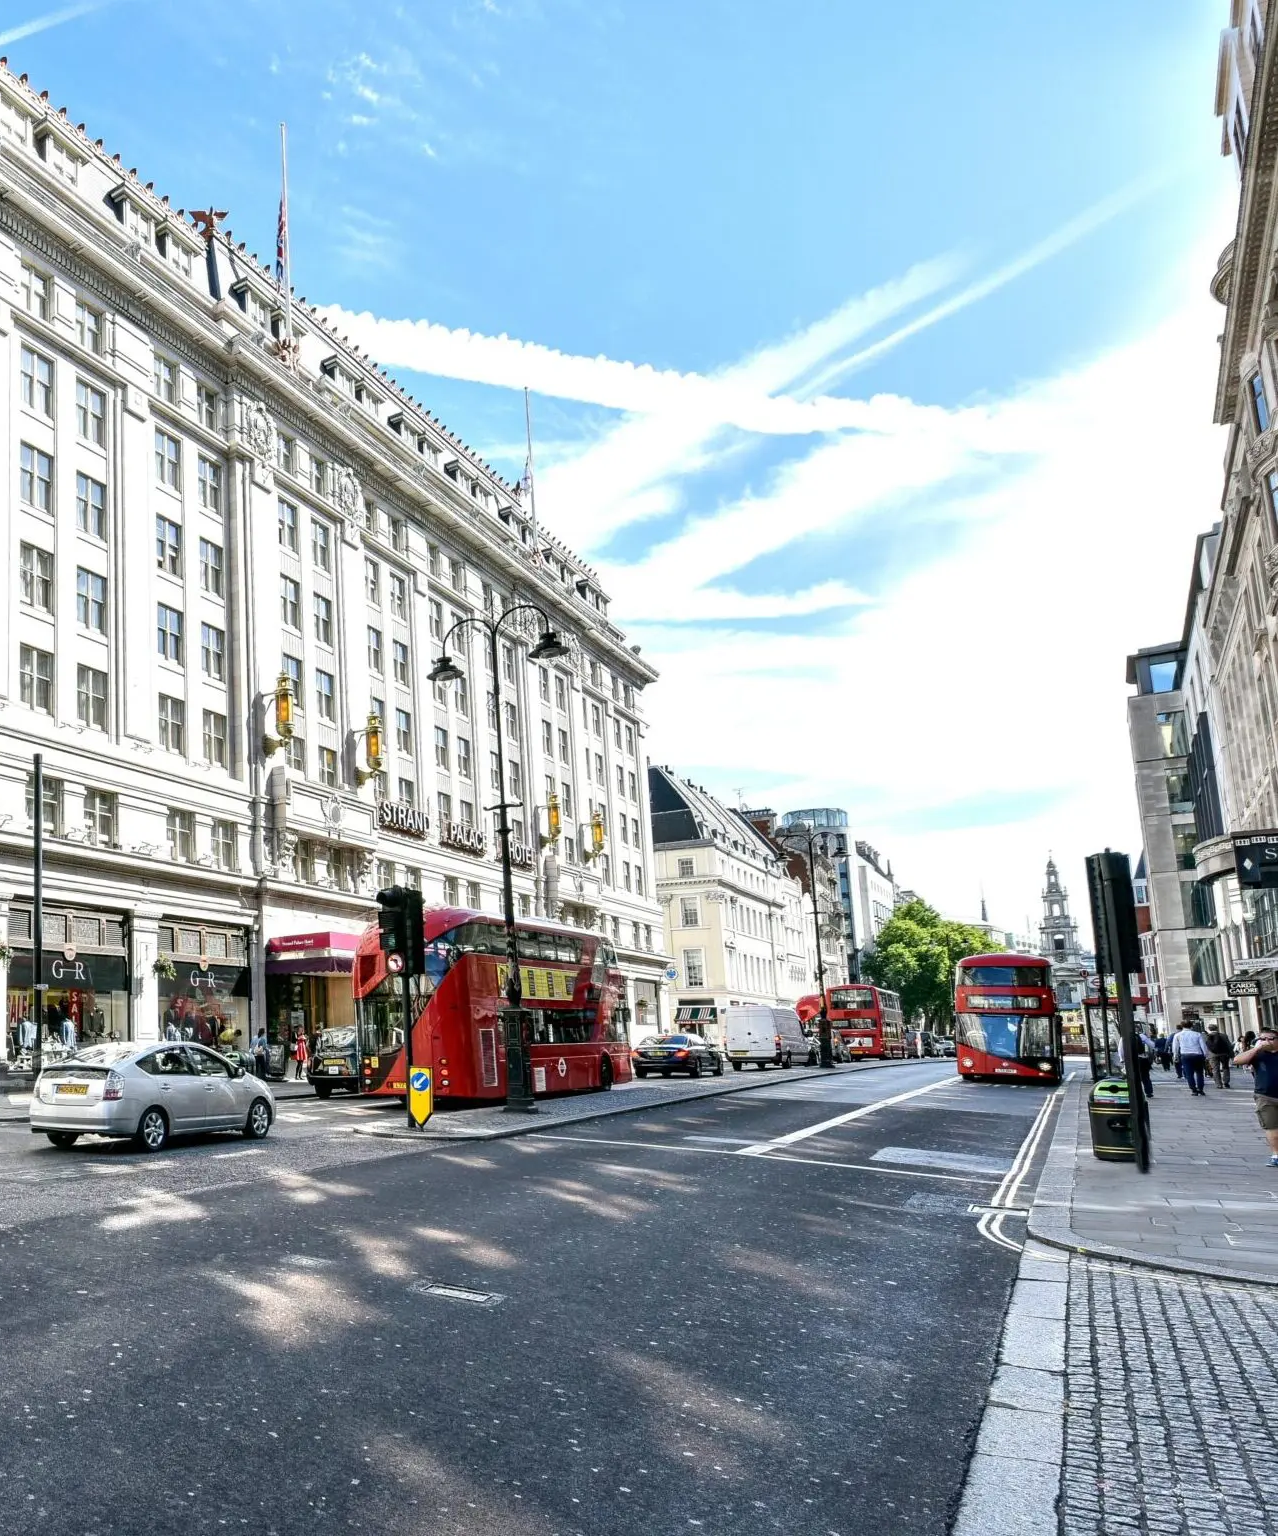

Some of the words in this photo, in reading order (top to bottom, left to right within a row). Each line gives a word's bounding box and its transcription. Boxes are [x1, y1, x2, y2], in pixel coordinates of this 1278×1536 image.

[383, 802, 430, 832] STRAND
[450, 823, 489, 850] PALACE
[508, 840, 536, 865] HOTEL
